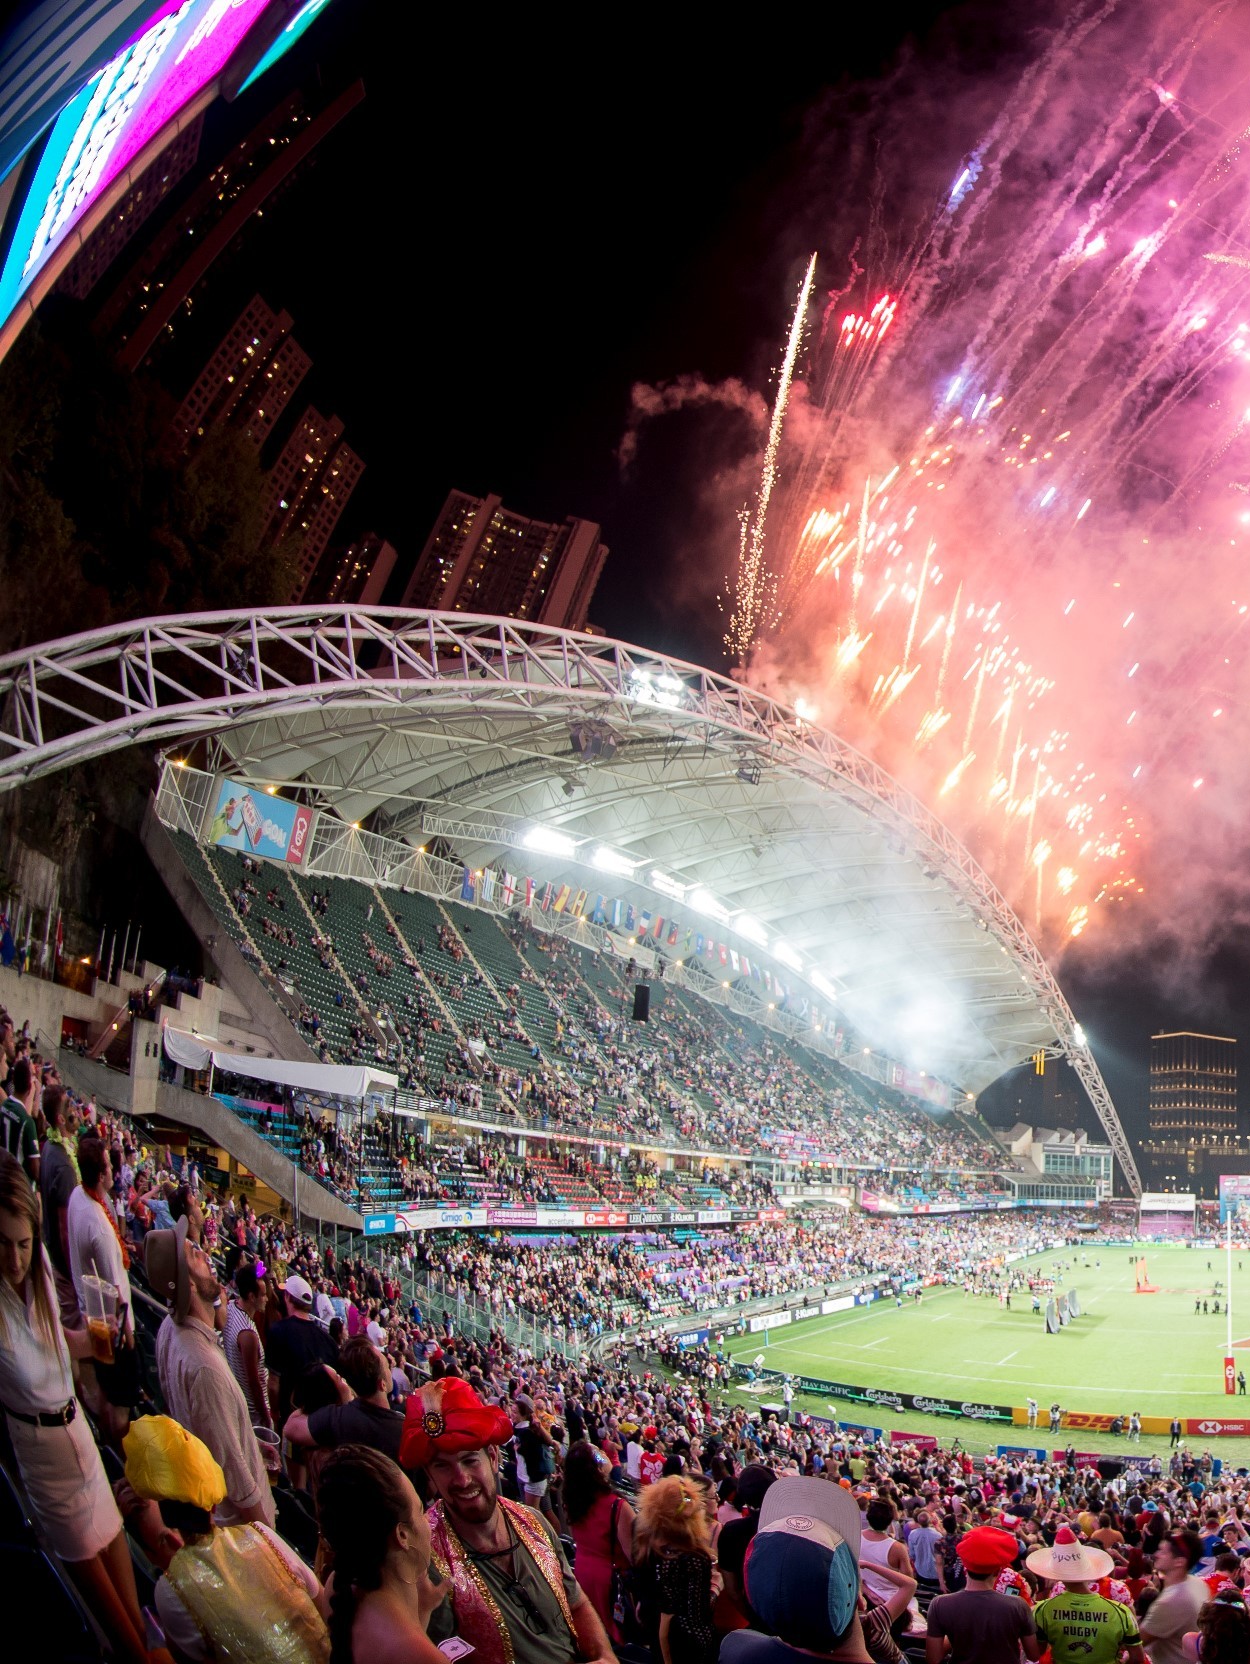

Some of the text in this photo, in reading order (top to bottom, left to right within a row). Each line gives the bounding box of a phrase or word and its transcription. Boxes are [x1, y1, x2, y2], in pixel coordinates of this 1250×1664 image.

[441, 1211, 463, 1224] Cimigo
[547, 1217, 575, 1225] accenture
[820, 1383, 851, 1396] PACIFIC
[866, 1388, 902, 1405] Carlsberg
[912, 1395, 950, 1412] Carlsberg
[961, 1402, 1000, 1419] Carlsberg
[1053, 1609, 1108, 1623] ZIMBABWE
[1063, 1626, 1098, 1637] RUGBY
